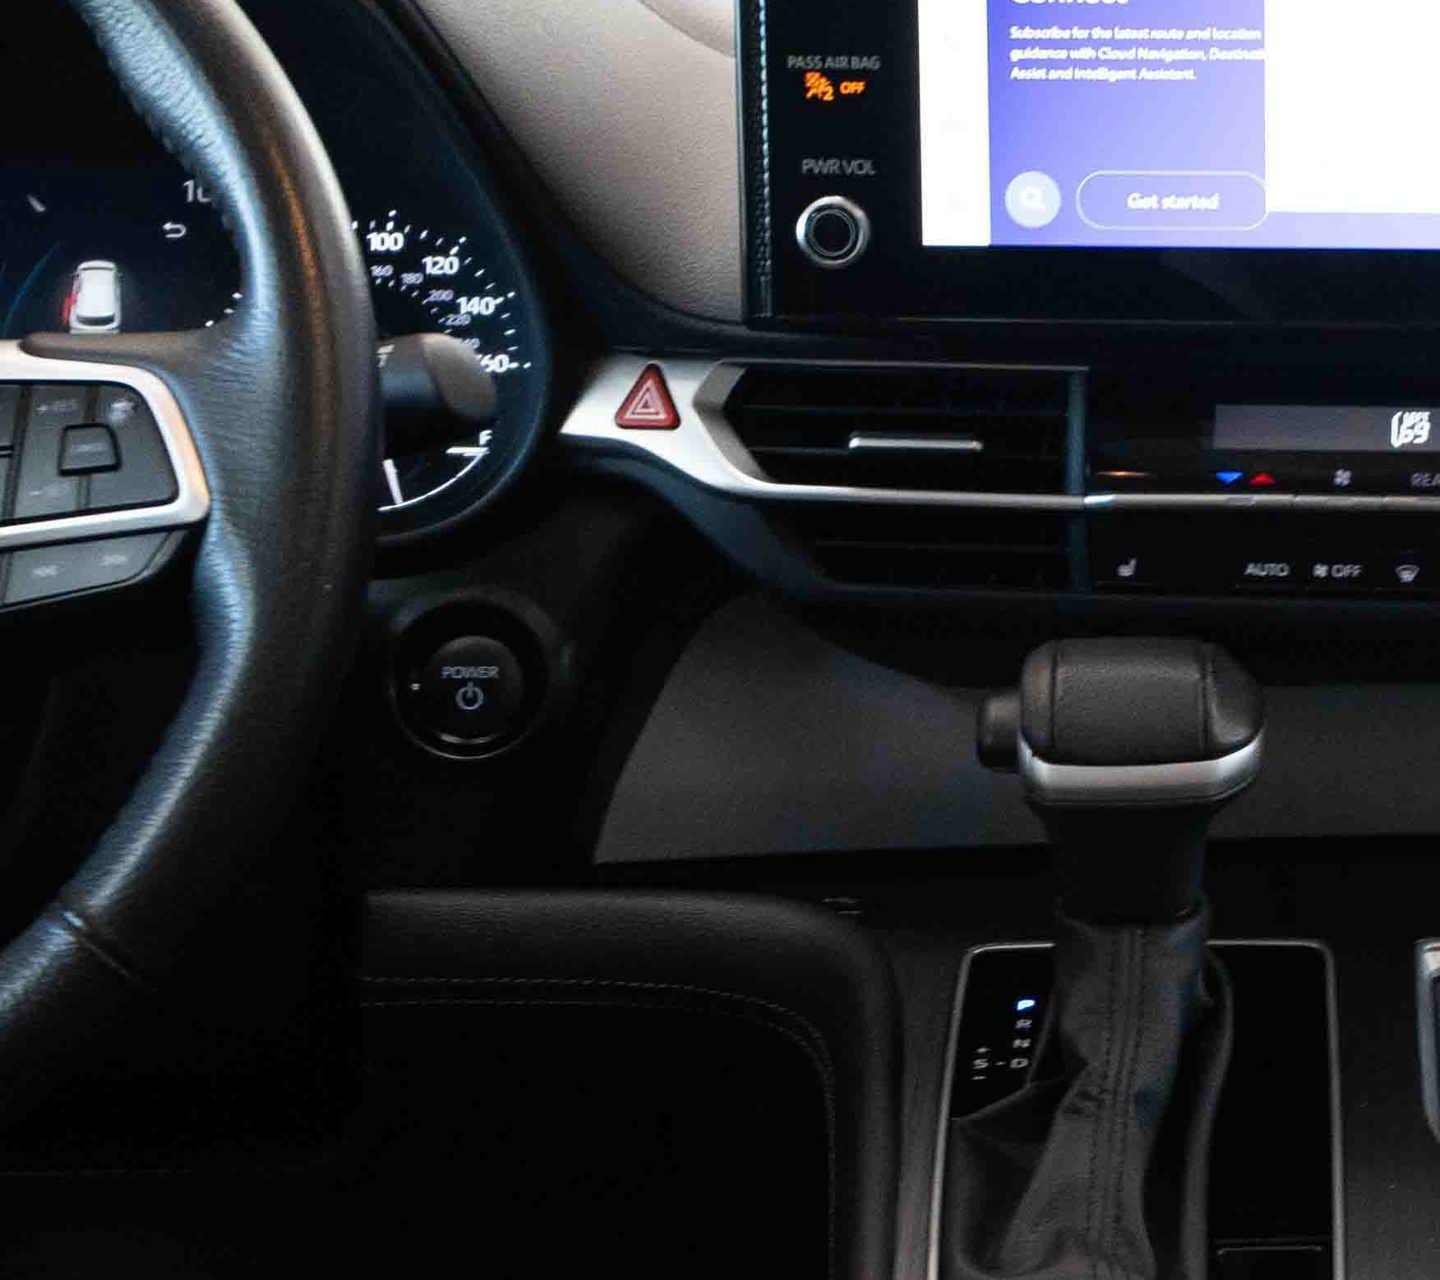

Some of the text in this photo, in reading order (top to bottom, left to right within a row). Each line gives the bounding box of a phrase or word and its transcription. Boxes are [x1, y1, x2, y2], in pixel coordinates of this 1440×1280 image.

[1009, 26, 1262, 40] Subscribe for the latest route and location
[788, 56, 823, 69] PASS
[1009, 47, 1068, 62] guidance
[1069, 47, 1097, 60] with
[1098, 47, 1136, 60] Cloud
[1137, 48, 1206, 63] Navigation,
[1010, 67, 1197, 83] Assist and Intelligent Assistant.
[840, 81, 864, 94] OFF
[802, 159, 876, 175] PWR VOL
[1127, 193, 1219, 209] Get started
[367, 232, 404, 251] 100
[422, 256, 459, 275] 120
[457, 297, 494, 316] 140
[479, 430, 493, 446] F
[1243, 562, 1290, 577] AUTO
[1331, 564, 1362, 579] OFF
[441, 666, 500, 680] POWER
